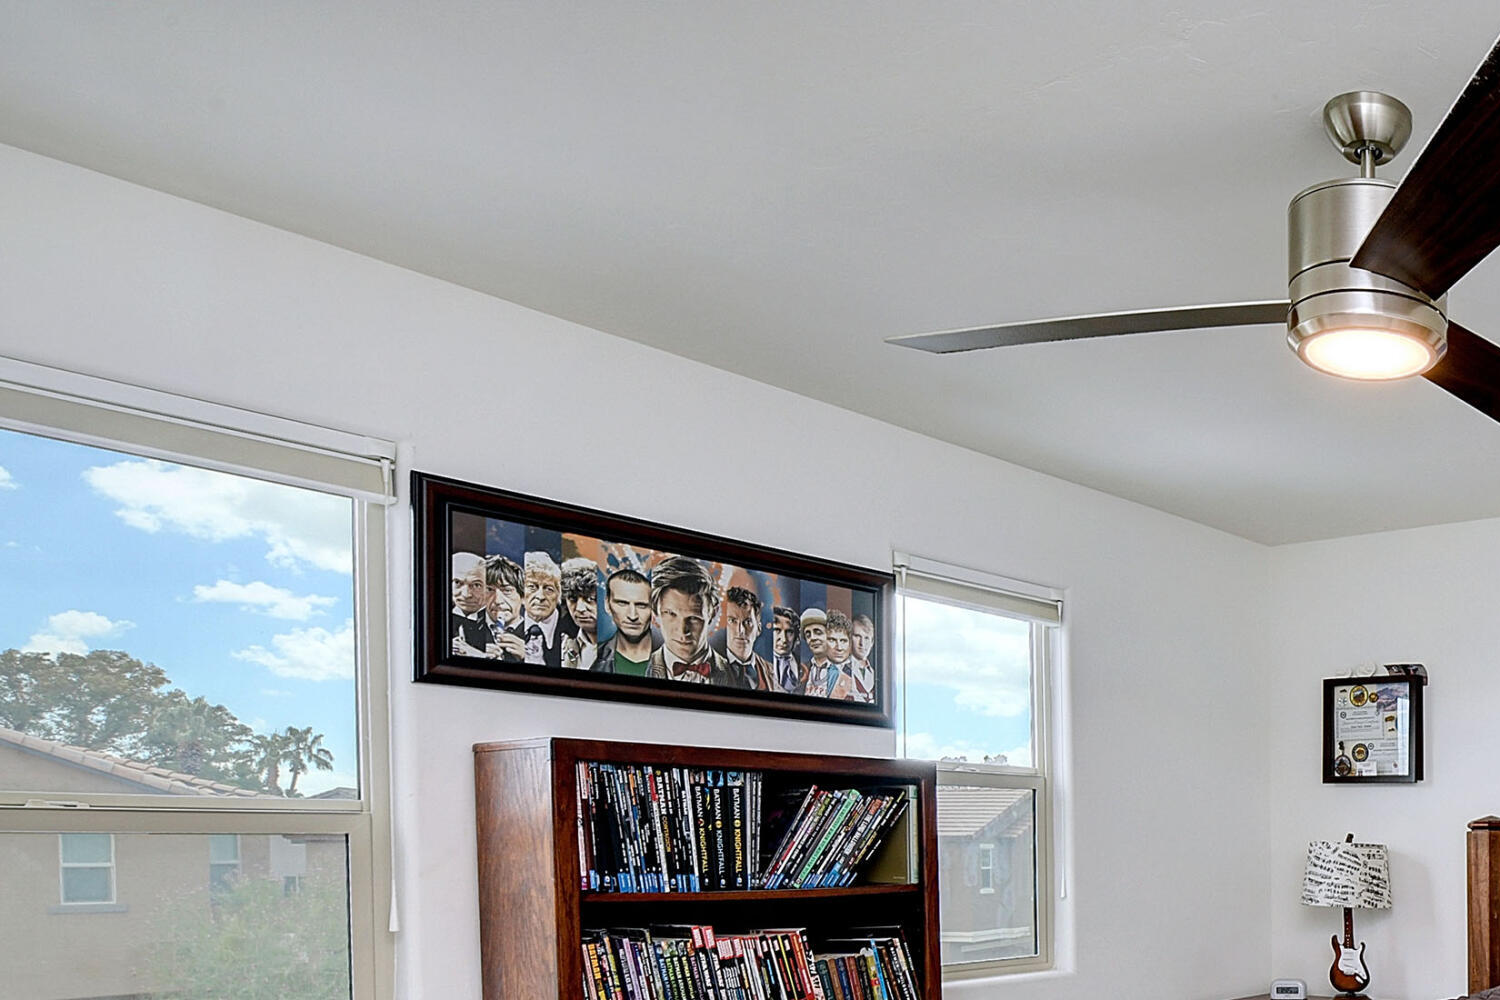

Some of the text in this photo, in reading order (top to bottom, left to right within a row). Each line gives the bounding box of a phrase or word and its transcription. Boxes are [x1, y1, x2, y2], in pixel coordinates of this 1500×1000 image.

[656, 776, 667, 814] BATMAN
[662, 816, 671, 852] CONTAGION
[695, 786, 708, 873] BATMAN KNIGHTFALL
[713, 789, 725, 875] BATMAN KNIGHTFALL
[588, 944, 601, 979] BATMAN
[658, 958, 669, 981] BATMAN
[665, 958, 674, 980] BATMAN
[673, 957, 681, 979] BATMAN
[678, 979, 686, 1000] ARKHAM
[681, 957, 690, 977] BATMAN
[686, 977, 695, 999] ARKHAM
[690, 957, 699, 978] BATMAN
[703, 970, 711, 987] WARS
[716, 970, 724, 987] WARS
